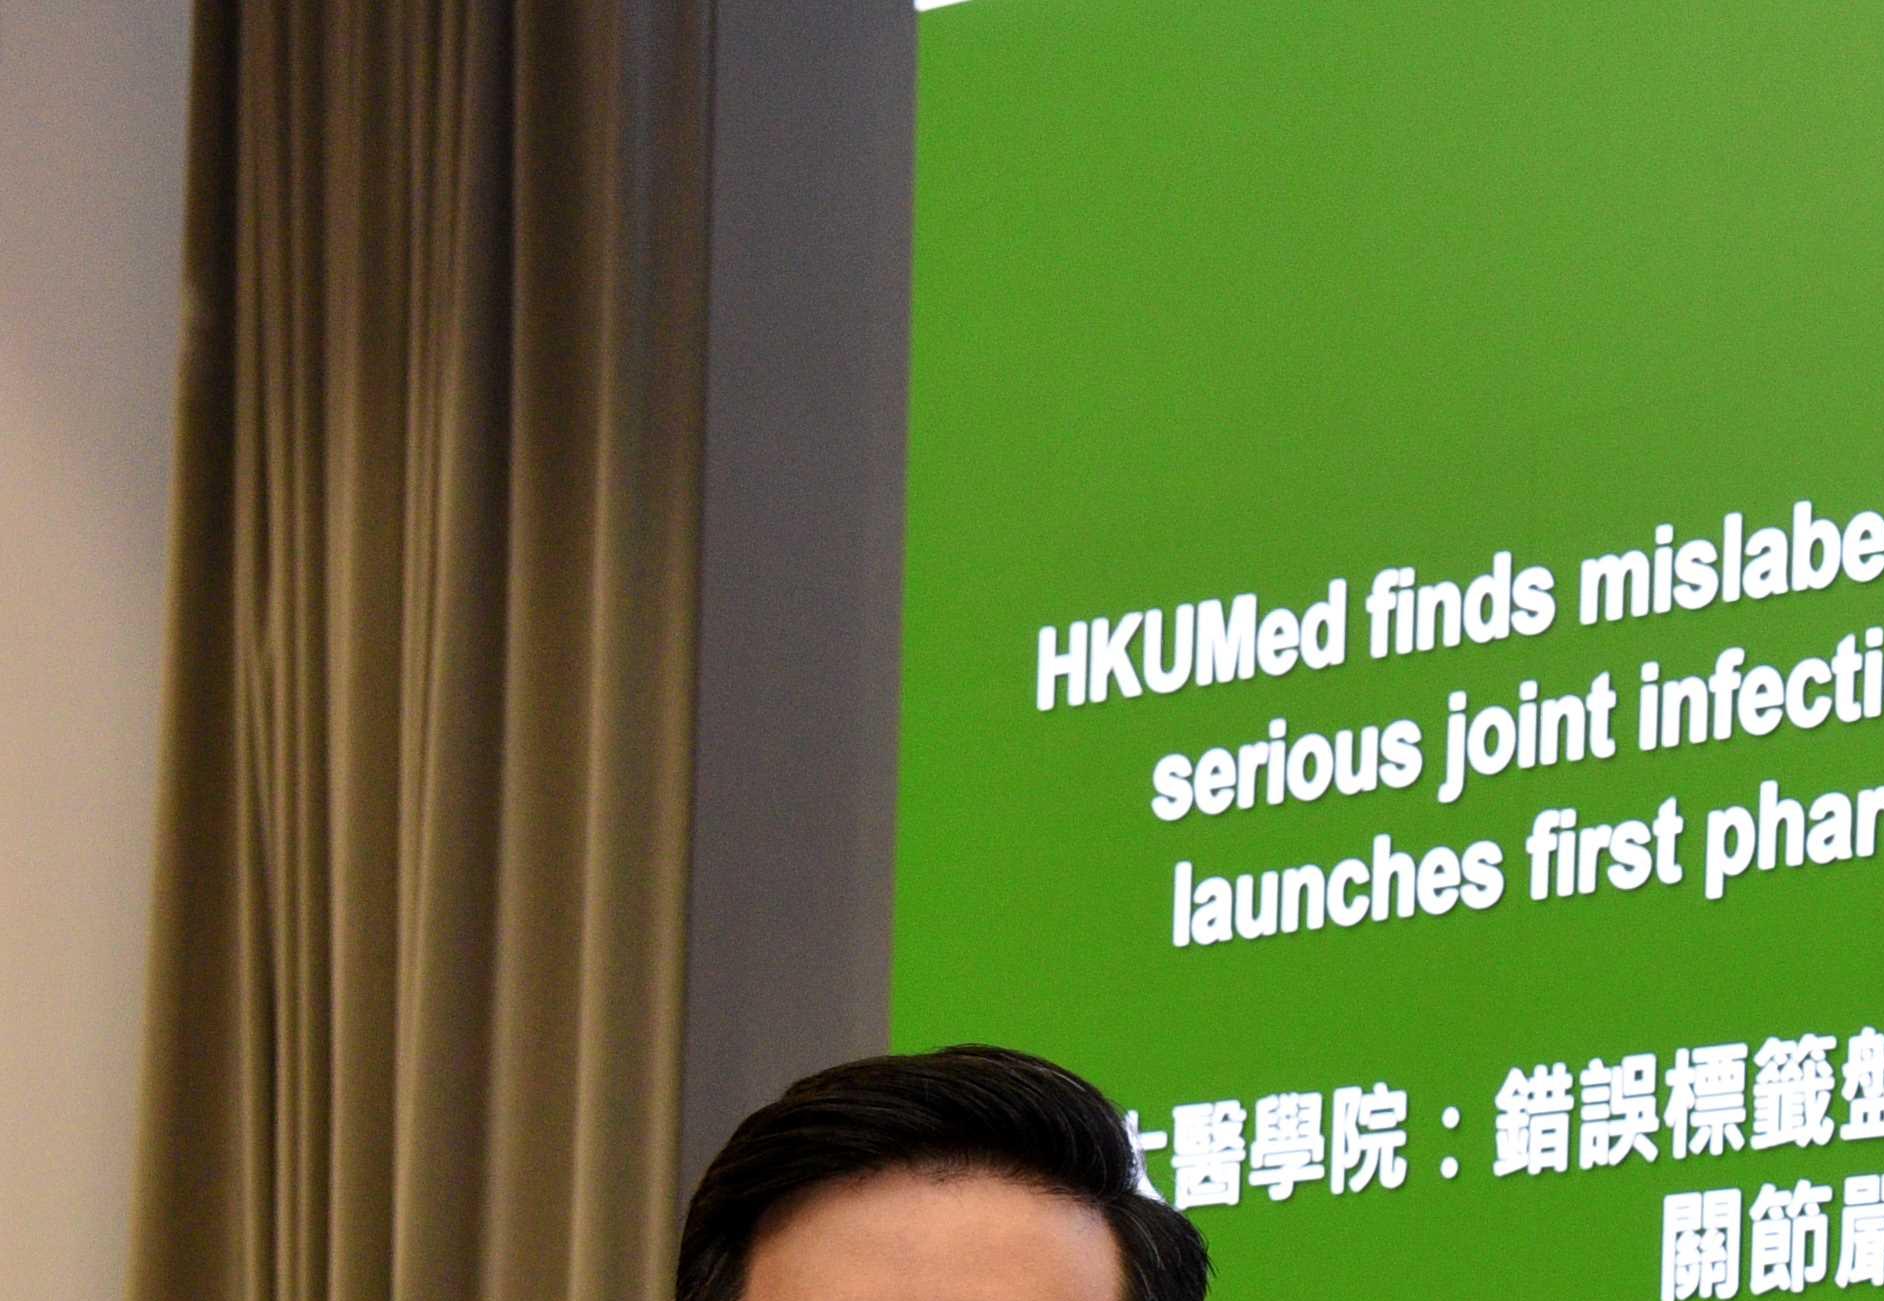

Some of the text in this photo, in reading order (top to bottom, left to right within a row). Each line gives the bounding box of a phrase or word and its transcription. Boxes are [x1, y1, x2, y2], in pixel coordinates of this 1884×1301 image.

[1036, 578, 1346, 711] HKUMed
[1365, 551, 1555, 658] finds
[1151, 718, 1422, 821] serious
[1438, 672, 1616, 803] joint
[1173, 834, 1503, 947] launches
[1526, 796, 1683, 900] first
